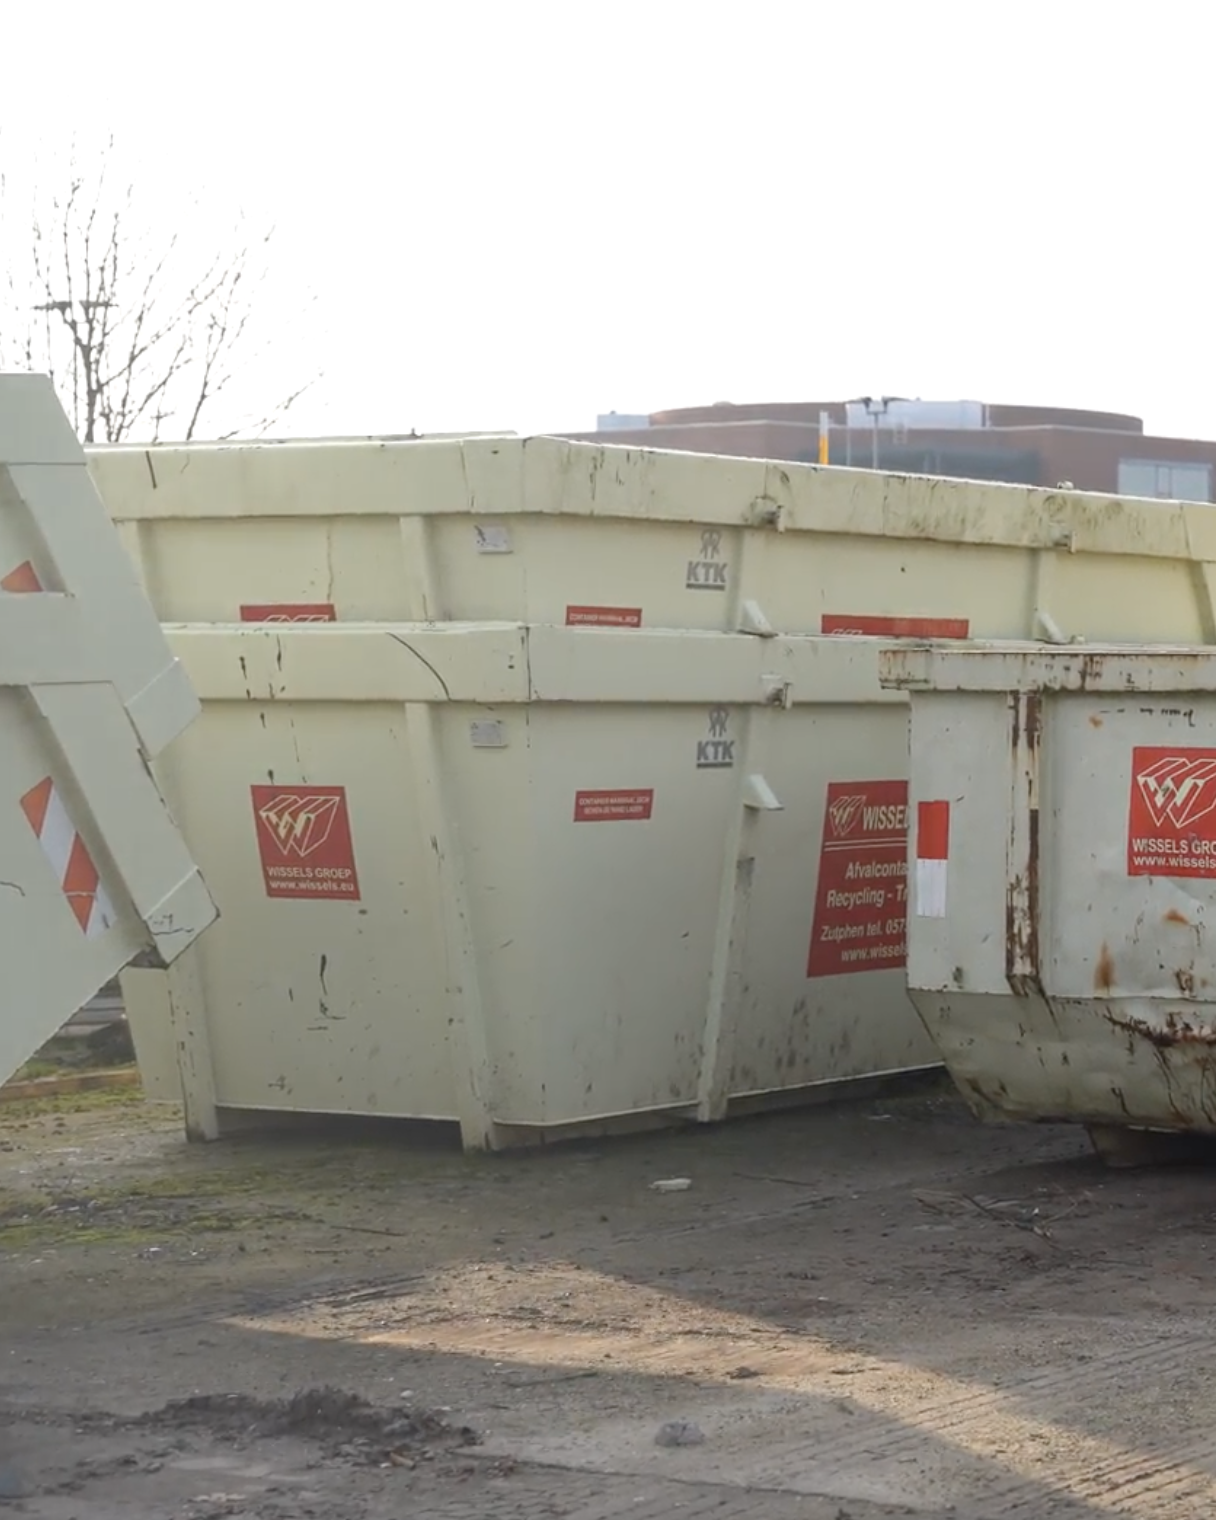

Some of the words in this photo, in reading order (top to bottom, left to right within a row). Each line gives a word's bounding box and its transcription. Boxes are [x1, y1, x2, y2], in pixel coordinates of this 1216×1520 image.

[686, 561, 728, 584] KTK
[697, 740, 735, 761] KTK
[1132, 838, 1189, 854] WISSELS
[267, 866, 313, 878] WISSELS
[315, 867, 352, 879] GROEP
[269, 880, 354, 892] www.wissels.eu
[827, 887, 885, 911] Recycling
[820, 924, 865, 944] Zutphen
[866, 920, 883, 937] tel.
